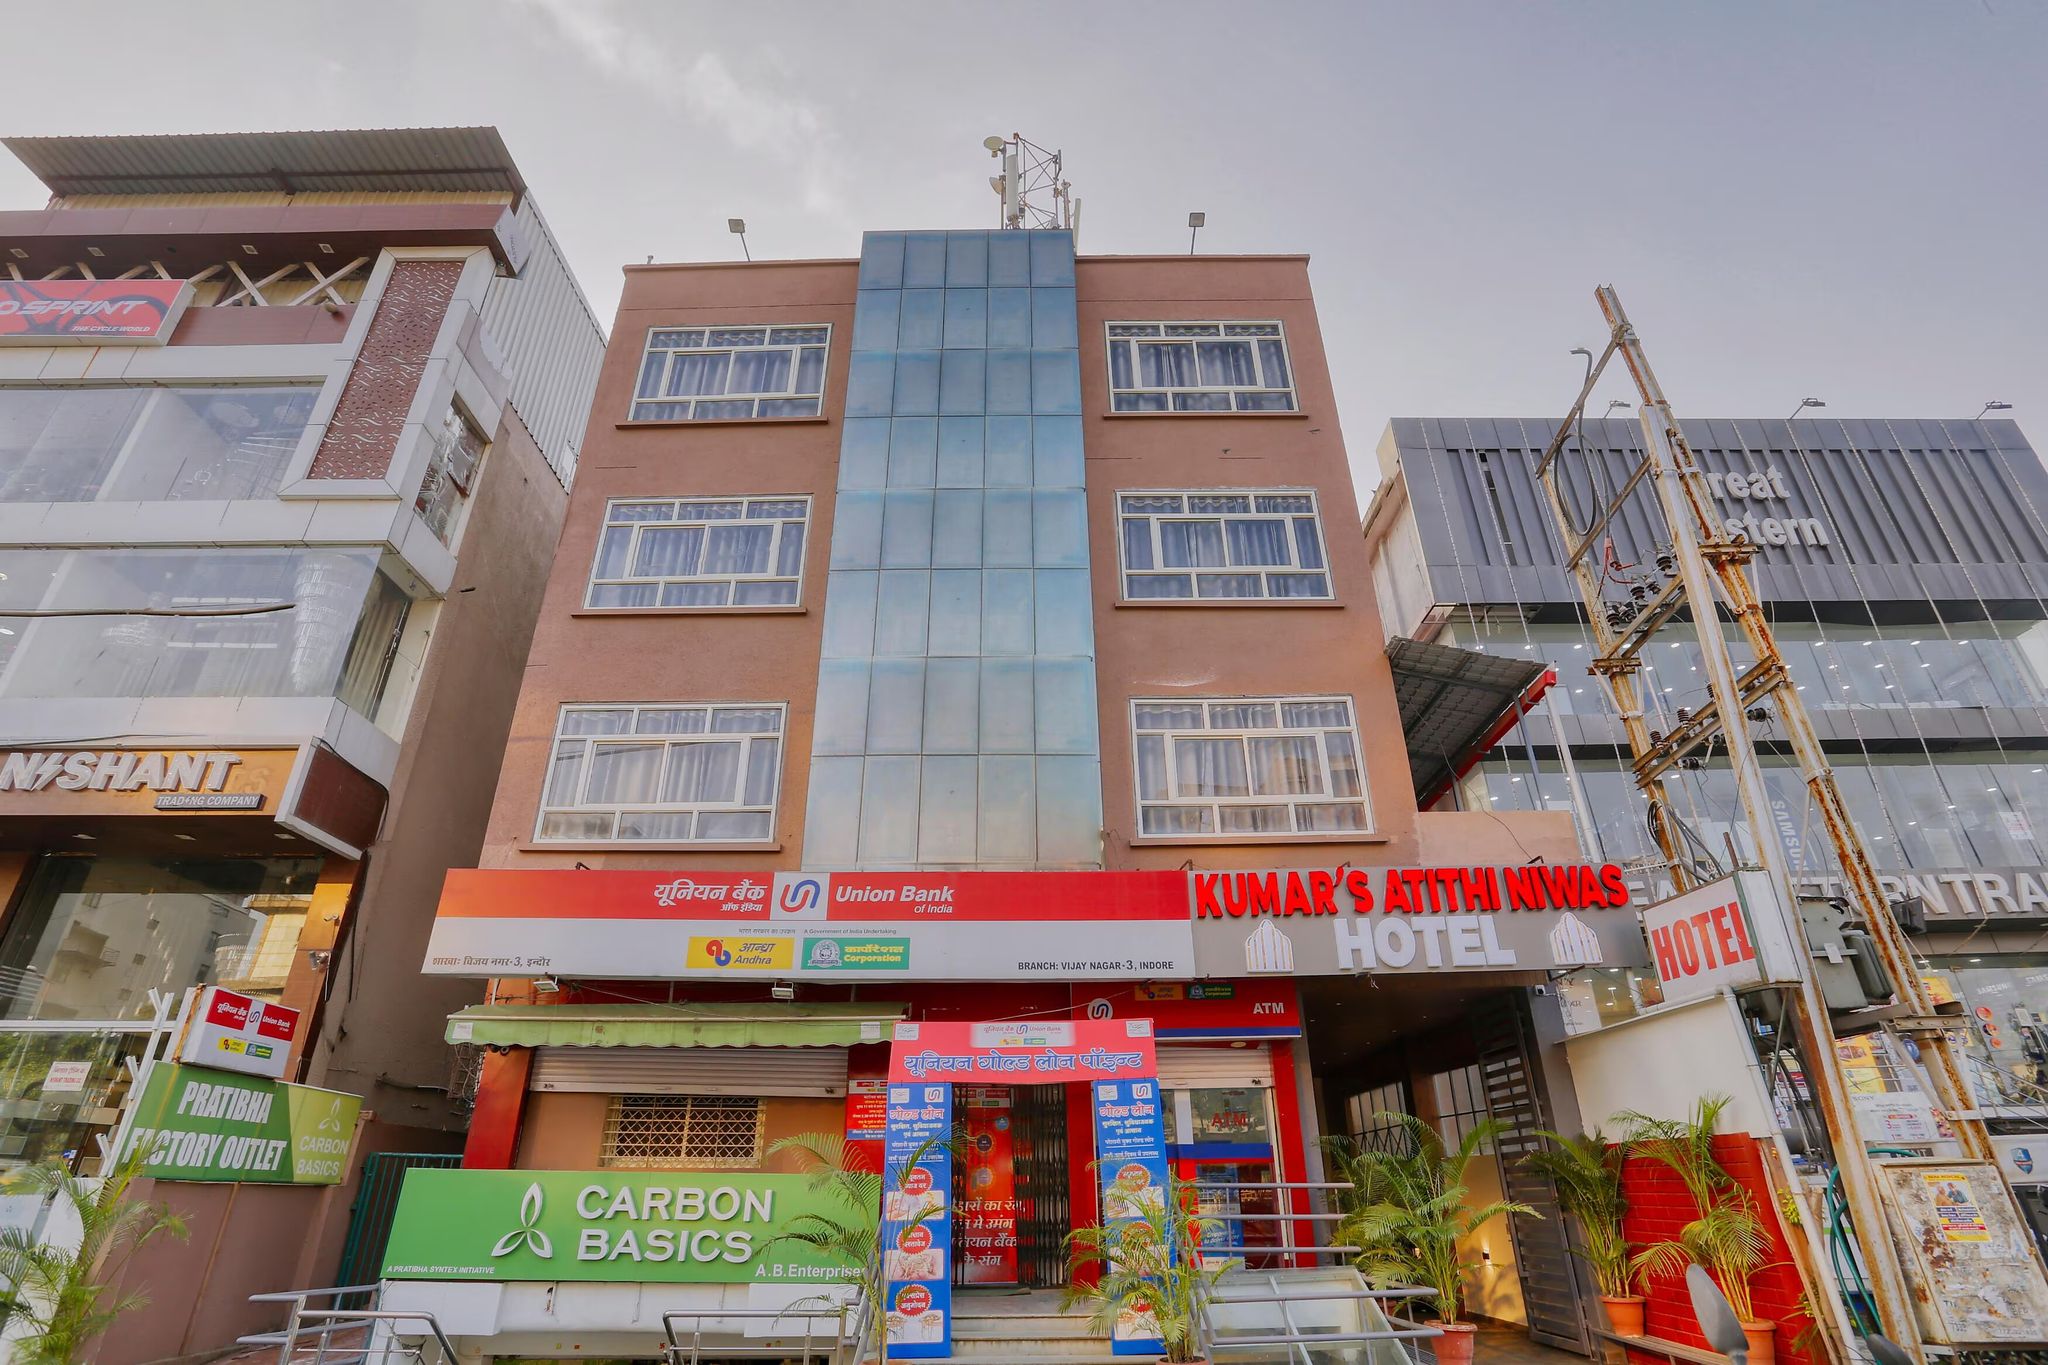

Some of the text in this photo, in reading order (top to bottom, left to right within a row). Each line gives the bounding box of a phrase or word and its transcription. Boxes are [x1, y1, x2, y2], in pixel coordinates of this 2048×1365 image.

[1705, 464, 1791, 500] reat
[1723, 510, 1830, 546] stern
[206, 796, 261, 806] COMPANY
[654, 878, 768, 907] यूनियन बैंक
[835, 885, 955, 902] Union Bank
[1195, 863, 1629, 919] KUMAR'S ATITHI NIWAS
[914, 904, 953, 914] of India
[1333, 914, 1517, 970] HOTEL
[1651, 901, 1756, 982] HOTEL
[733, 955, 772, 965] Andhra
[843, 954, 902, 964] Corporation
[1018, 961, 1059, 971] BRANCH:
[1061, 961, 1087, 971] VIJAY
[1139, 961, 1174, 970] INDORE
[1253, 1002, 1285, 1014] ATM
[904, 1050, 974, 1078] यूनियन
[1035, 1048, 1075, 1071] लोन
[177, 1081, 273, 1124] PRATIBHA
[921, 1104, 945, 1120] लोन
[1131, 1101, 1154, 1116] लोन
[1211, 1112, 1248, 1129] ATM
[218, 1135, 288, 1171] OUTLET
[299, 1135, 350, 1155] CARBON
[296, 1159, 341, 1177] BASICS
[576, 1184, 774, 1223] CARBON
[577, 1229, 753, 1263] BASICS
[459, 1266, 496, 1274] INITIATIVE
